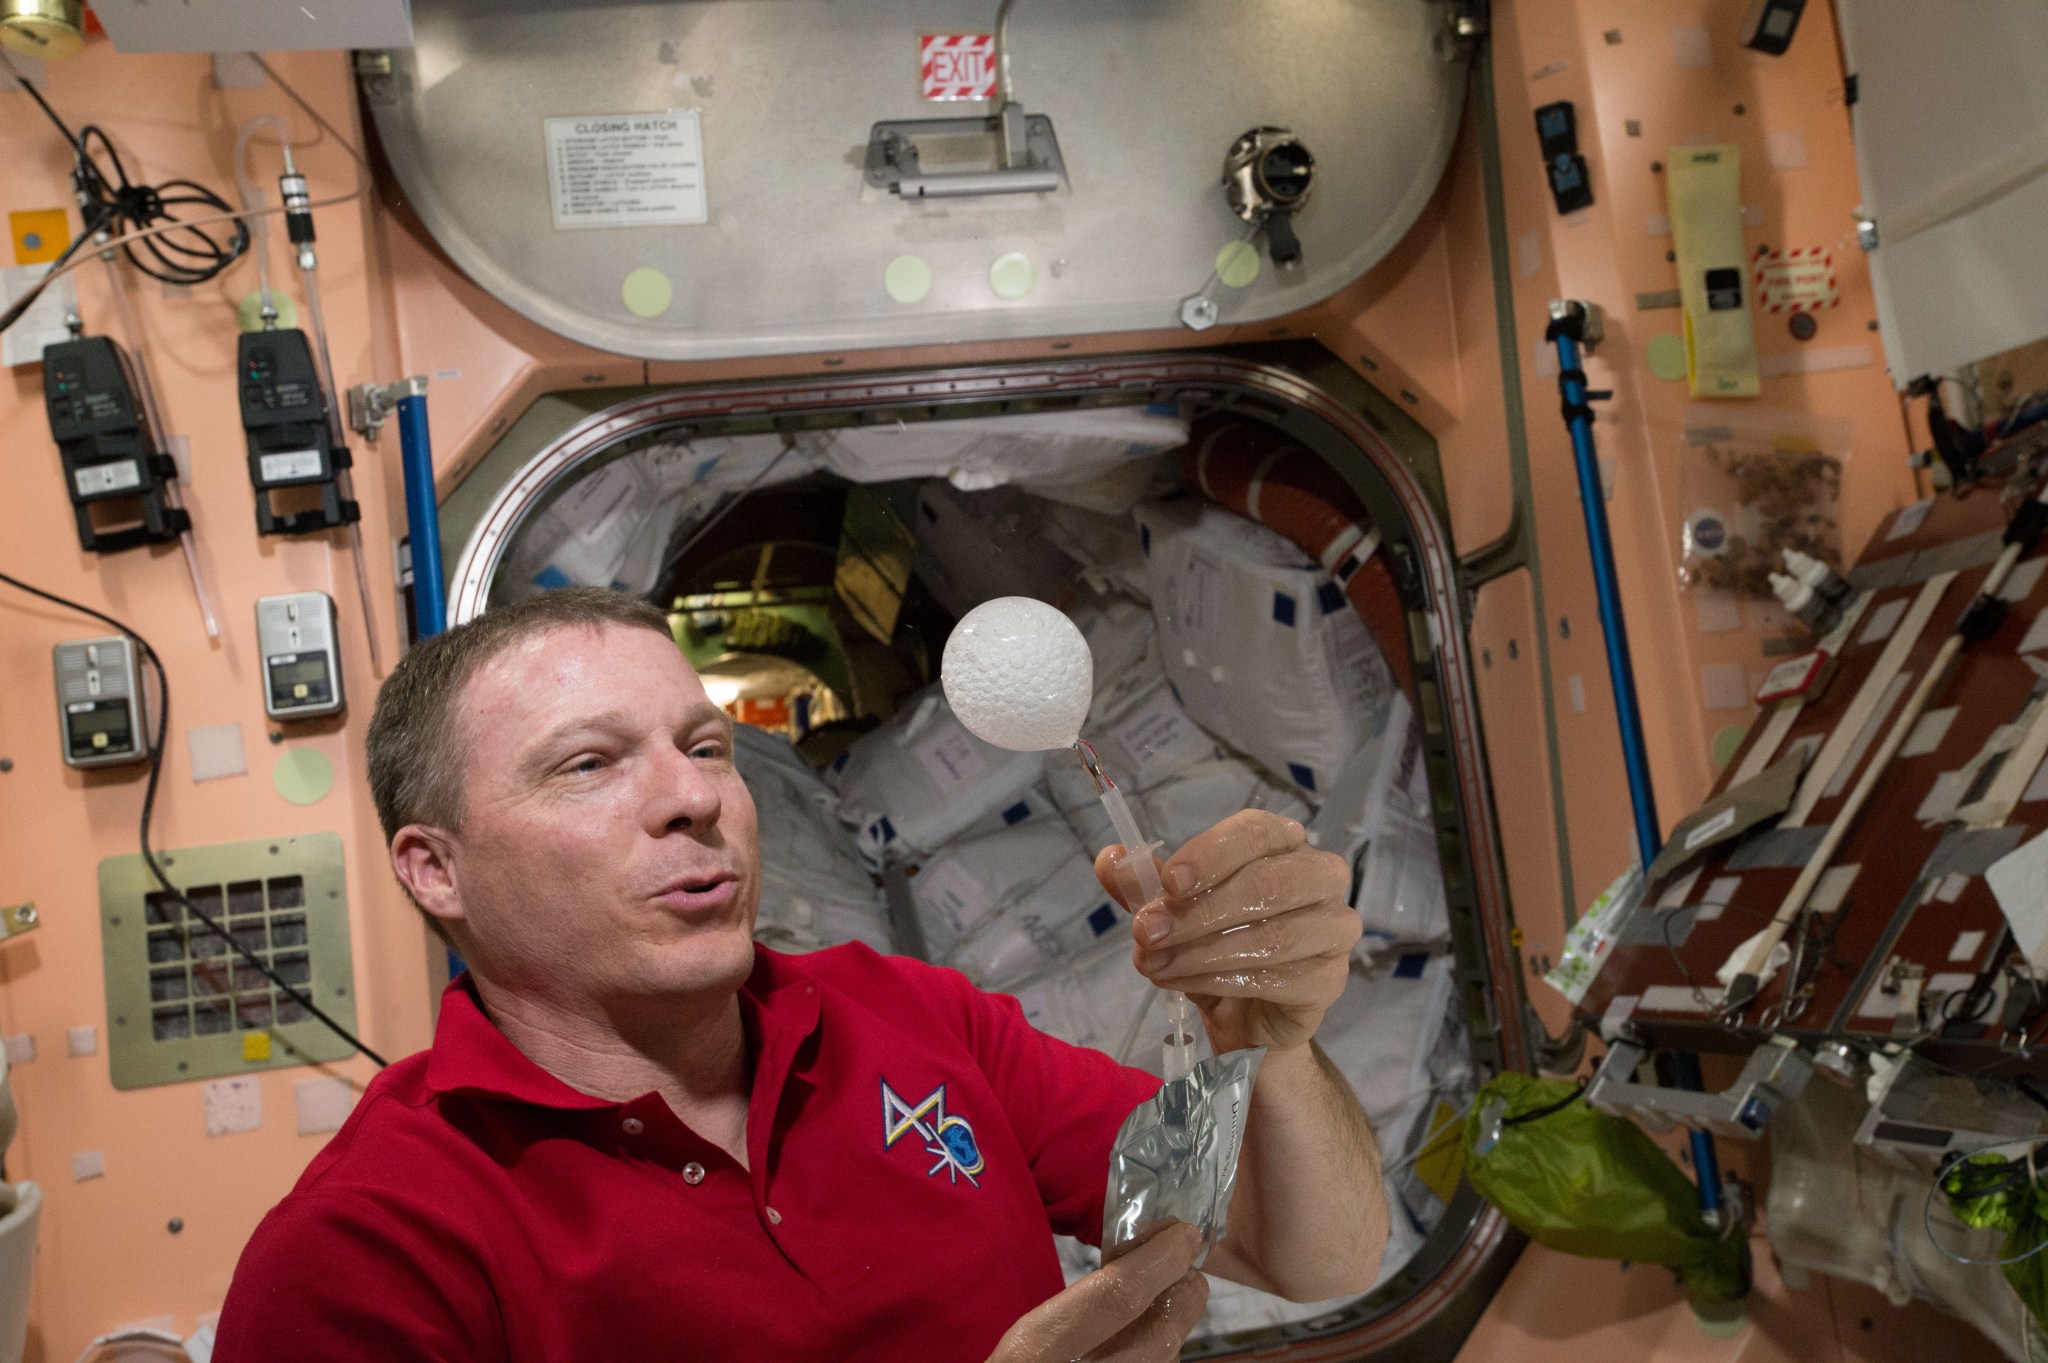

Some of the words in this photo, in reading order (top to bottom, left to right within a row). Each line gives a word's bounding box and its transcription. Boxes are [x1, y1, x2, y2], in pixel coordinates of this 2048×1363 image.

[933, 51, 983, 82] EXIT
[575, 121, 630, 134] CLOSING
[634, 120, 677, 131] HATCH
[1226, 1100, 1240, 1161] Drinking
